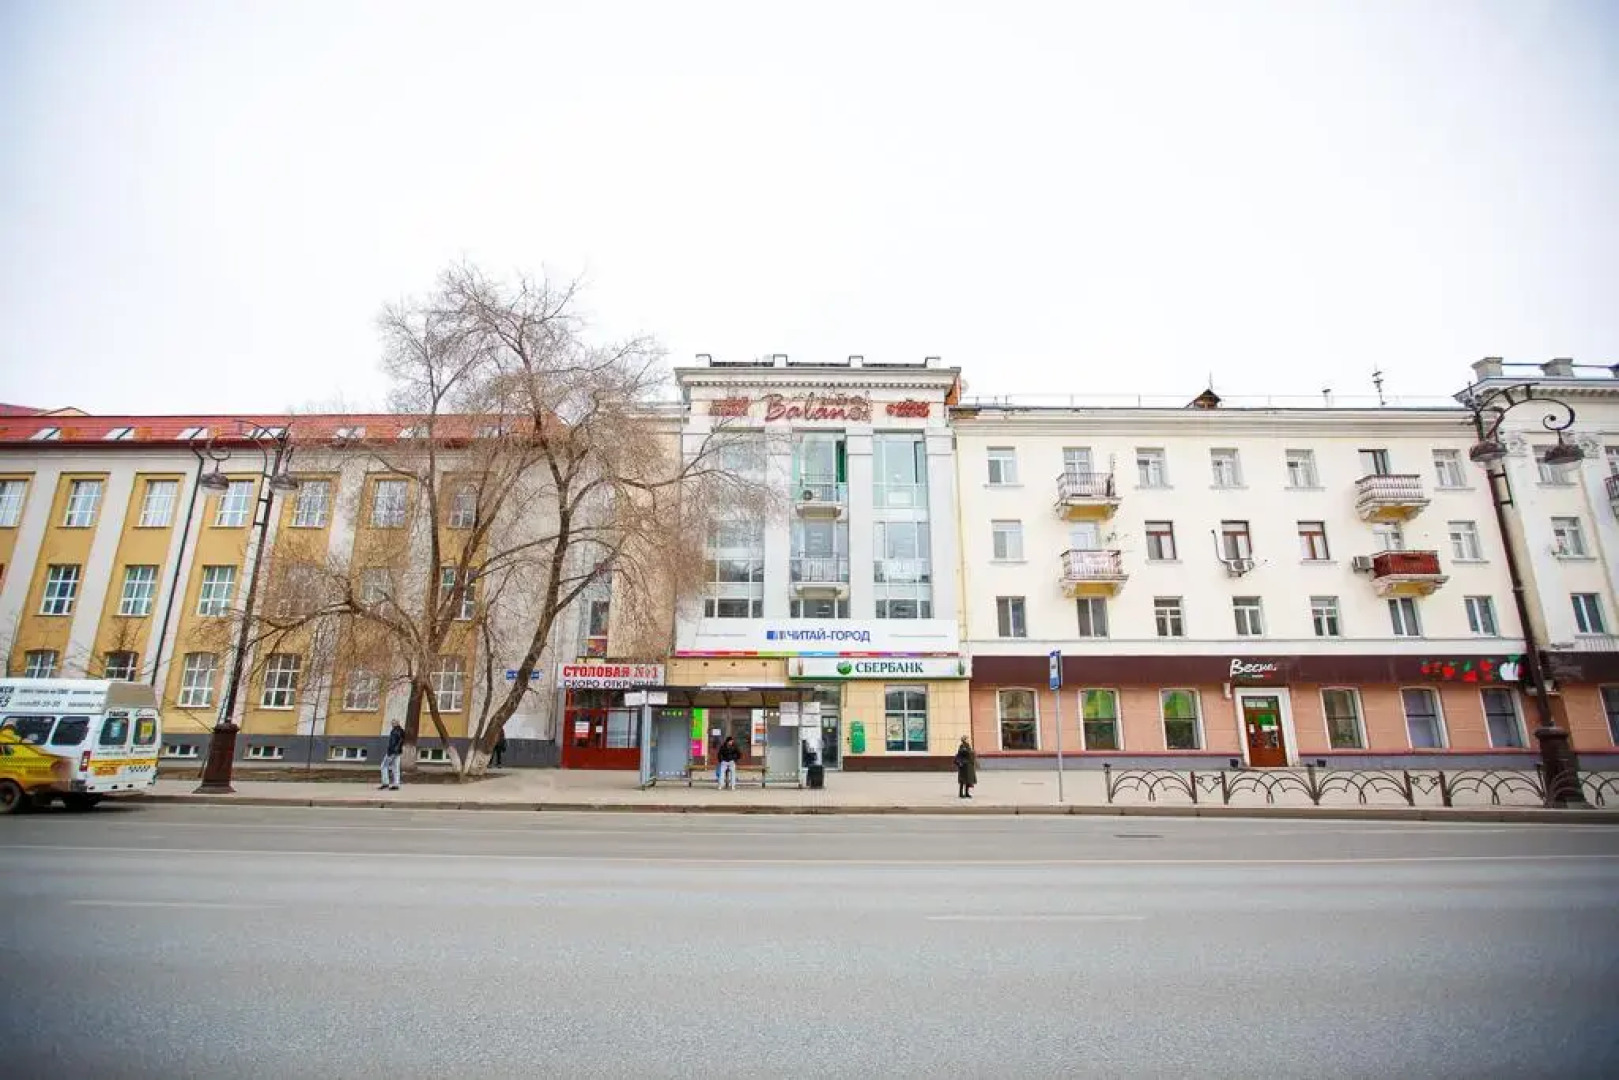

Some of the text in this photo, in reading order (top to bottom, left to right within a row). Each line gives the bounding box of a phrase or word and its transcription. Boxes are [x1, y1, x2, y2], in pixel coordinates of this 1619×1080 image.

[787, 628, 870, 642] ЧИТАЙ-ГОРОД
[563, 665, 631, 678] СТОЛОВАЯ
[855, 662, 924, 673] СБЕРБАНК
[564, 680, 599, 689] СКОРО
